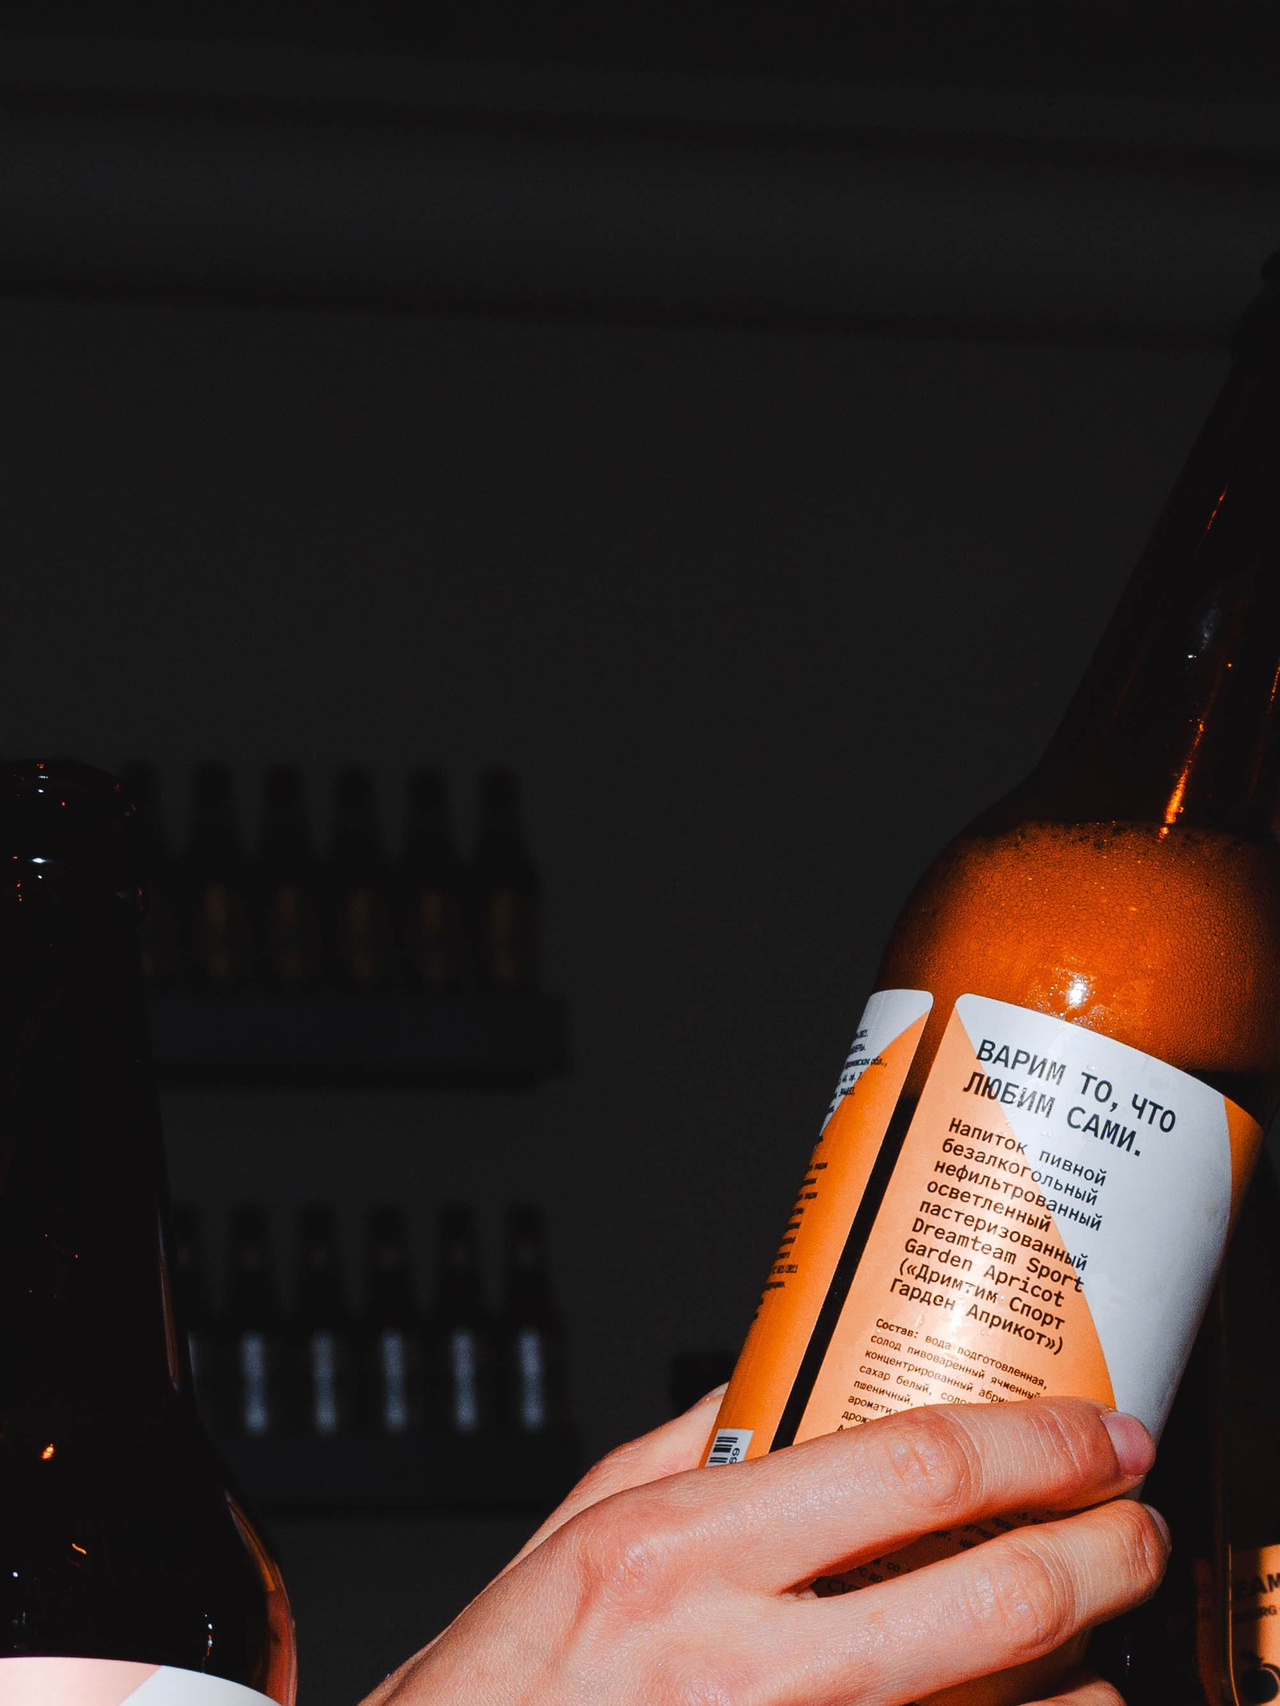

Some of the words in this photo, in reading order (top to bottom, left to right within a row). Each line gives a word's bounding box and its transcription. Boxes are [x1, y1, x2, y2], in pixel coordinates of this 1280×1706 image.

[963, 1071, 1055, 1118] ЛЮБИМ
[1067, 1106, 1141, 1157] САМИ.
[976, 1039, 1067, 1085] ВАРИМ
[1080, 1072, 1118, 1112] ТО,
[1131, 1093, 1176, 1132] ЧТО
[942, 1138, 1098, 1206] безалкогольный
[949, 1117, 1028, 1156] Напиток
[1039, 1150, 1107, 1187] пивной
[927, 1181, 1052, 1233] осветленный
[933, 1158, 1103, 1232] нефильтрованный
[912, 1217, 1017, 1265] Dreamteam
[1026, 1257, 1085, 1293] Sport
[919, 1201, 1088, 1271] пастеризованный
[899, 1257, 998, 1304] («Дримтим
[1009, 1296, 1066, 1331] Спорт
[904, 1238, 973, 1272] Garden
[983, 1264, 1066, 1308] Apricot
[890, 1278, 957, 1312] Гарден
[966, 1305, 1064, 1356] Априкот»)
[859, 1364, 891, 1382] сахар
[896, 1374, 932, 1397] белый,
[940, 1391, 971, 1405] соло
[865, 1350, 974, 1393] концентрированный
[978, 1388, 1009, 1404] абри
[870, 1334, 902, 1352] солод
[907, 1345, 986, 1380] пивоваренный
[875, 1318, 919, 1340] Состав:
[925, 1335, 952, 1351] вода
[957, 1346, 1048, 1391] подготовленная,
[841, 1411, 872, 1424] дрож
[853, 1380, 914, 1407] пшеничный,
